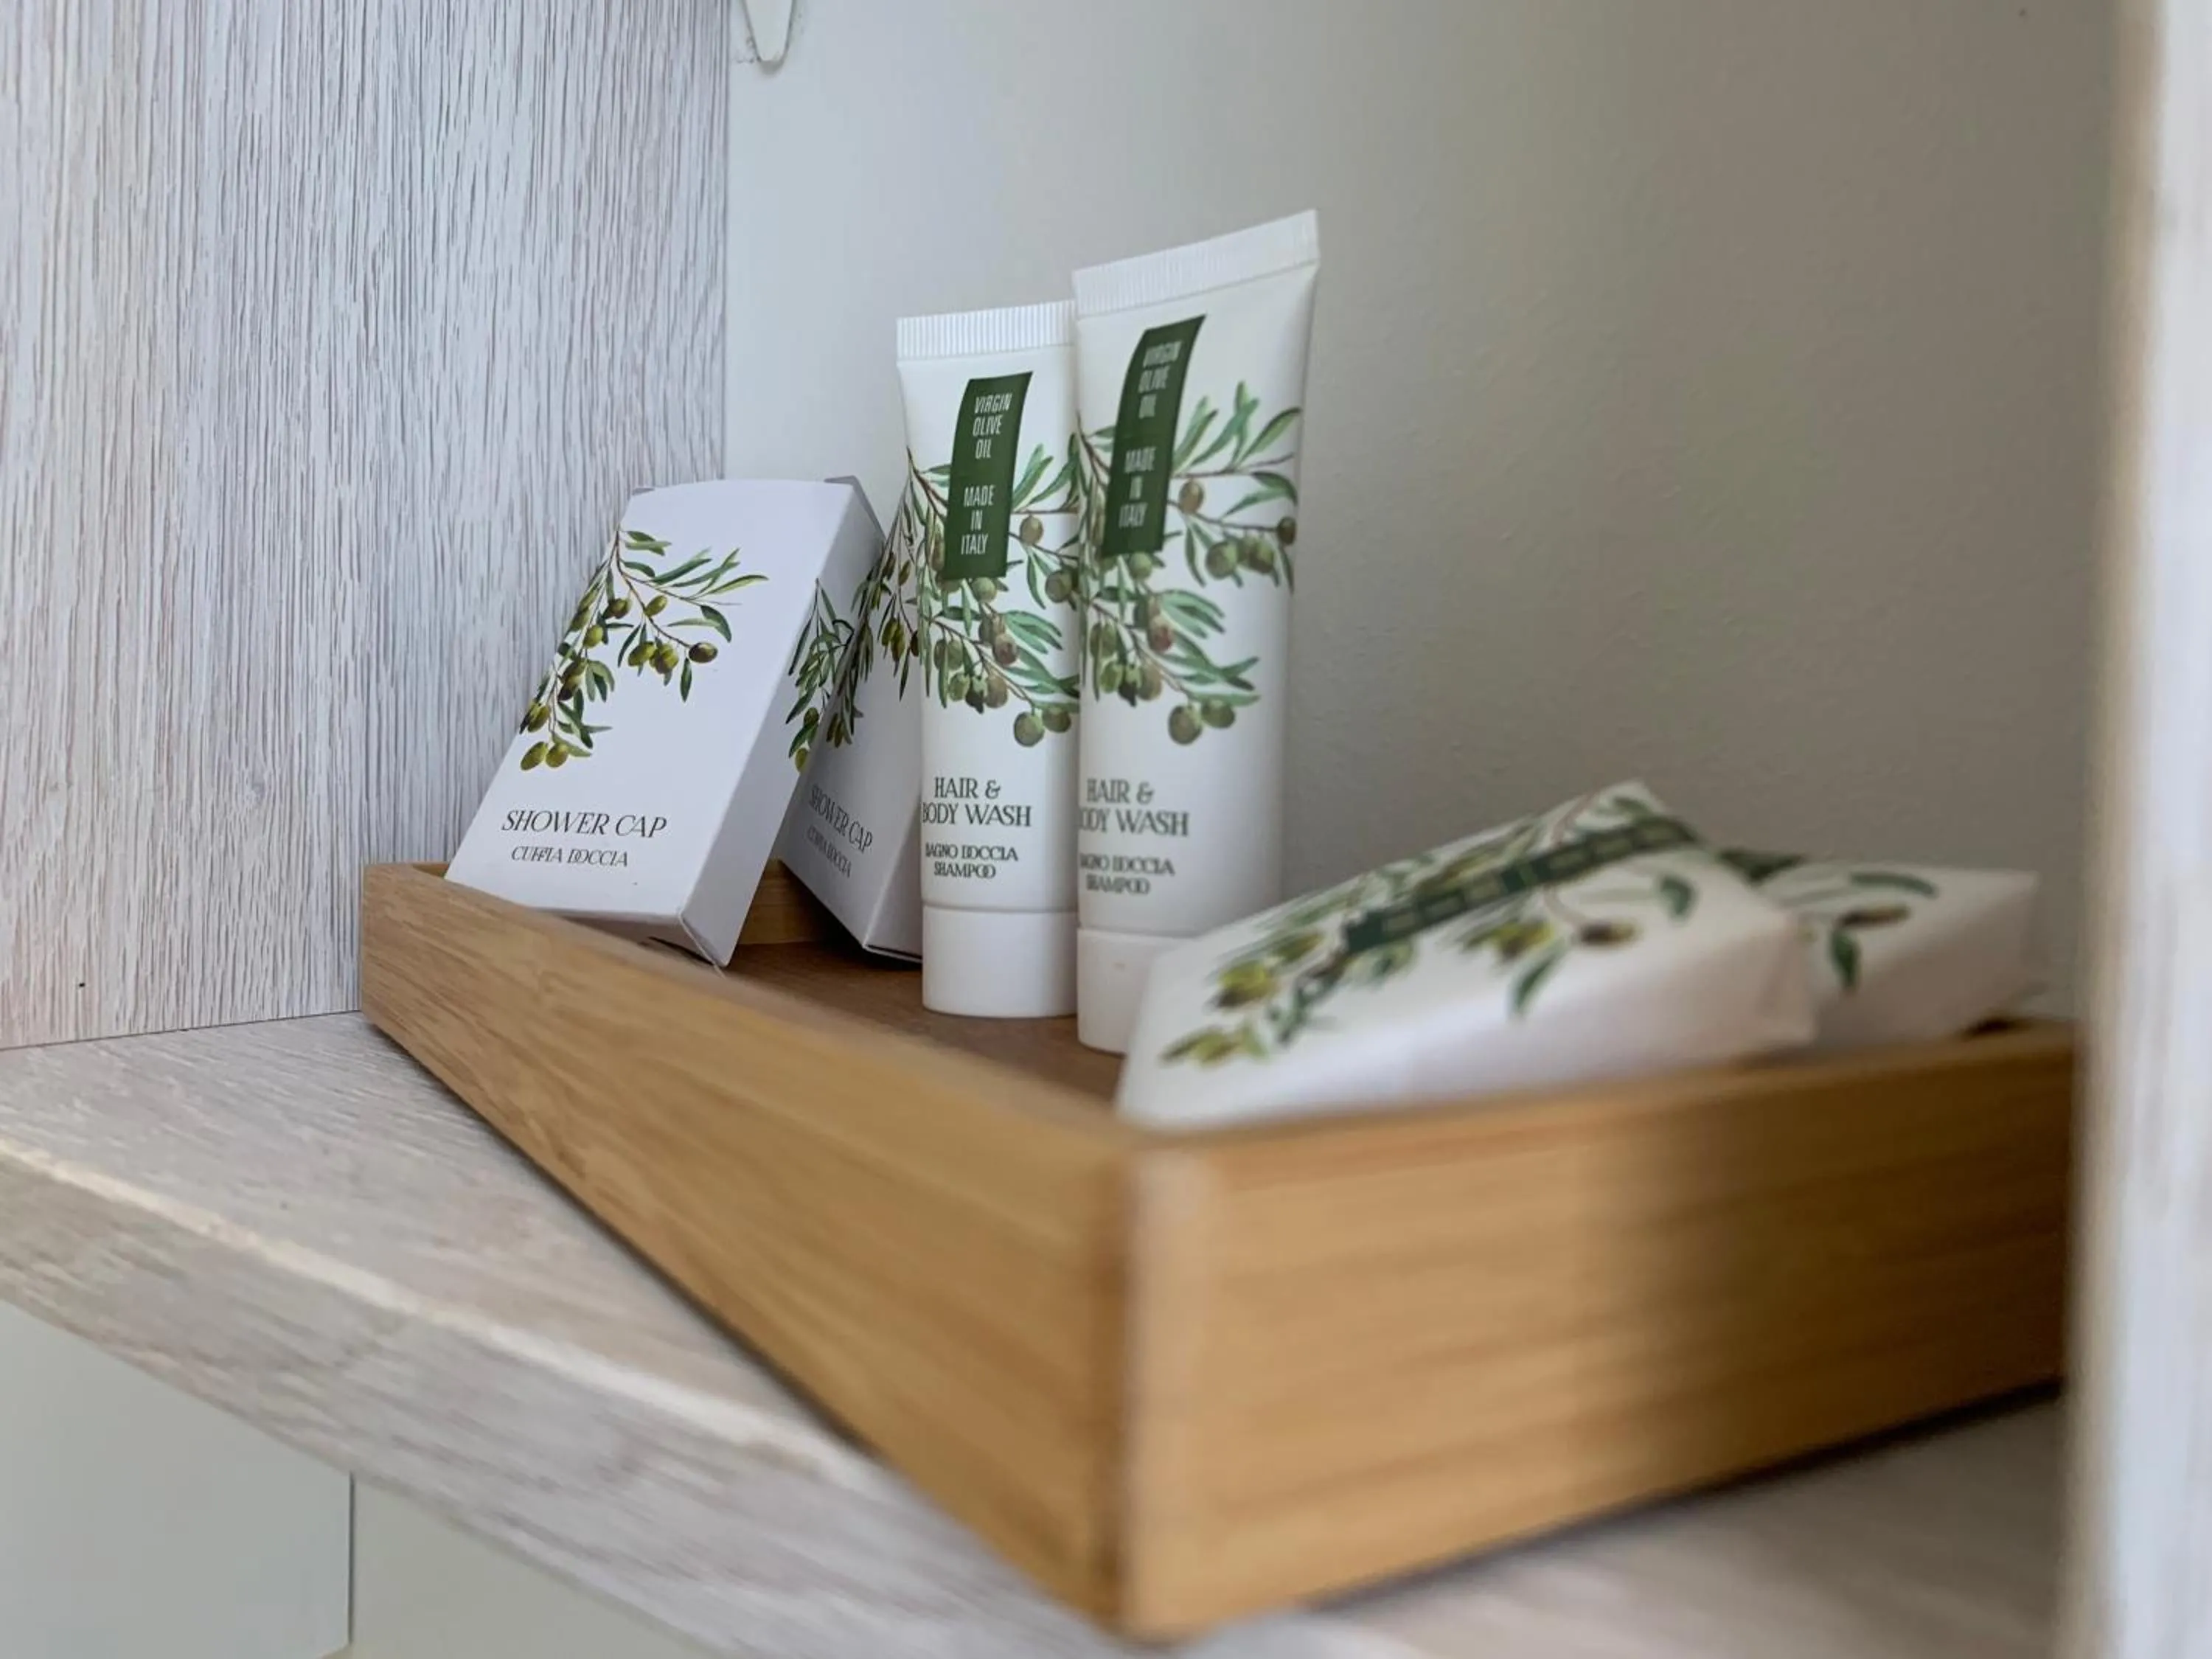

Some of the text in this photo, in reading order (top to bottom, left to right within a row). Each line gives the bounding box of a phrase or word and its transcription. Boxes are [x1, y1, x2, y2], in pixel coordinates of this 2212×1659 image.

[974, 392, 1012, 414] VIRGIN
[973, 414, 1004, 437] OLIVE
[975, 439, 992, 459] OIL
[963, 484, 995, 507] MADE
[970, 509, 984, 531] IN
[961, 533, 989, 554] ITALY
[934, 776, 1001, 799] HAIR &
[1086, 778, 1155, 805] HAIR &
[501, 810, 668, 838] SHOWER CAP
[964, 803, 1032, 827] WASH
[1078, 807, 1190, 837] ODY WASH
[849, 821, 873, 854] CAP
[511, 845, 628, 867] CUFFIA DOCCIA
[961, 844, 1018, 861] DOCCIA
[933, 860, 997, 879] SHAMPOO
